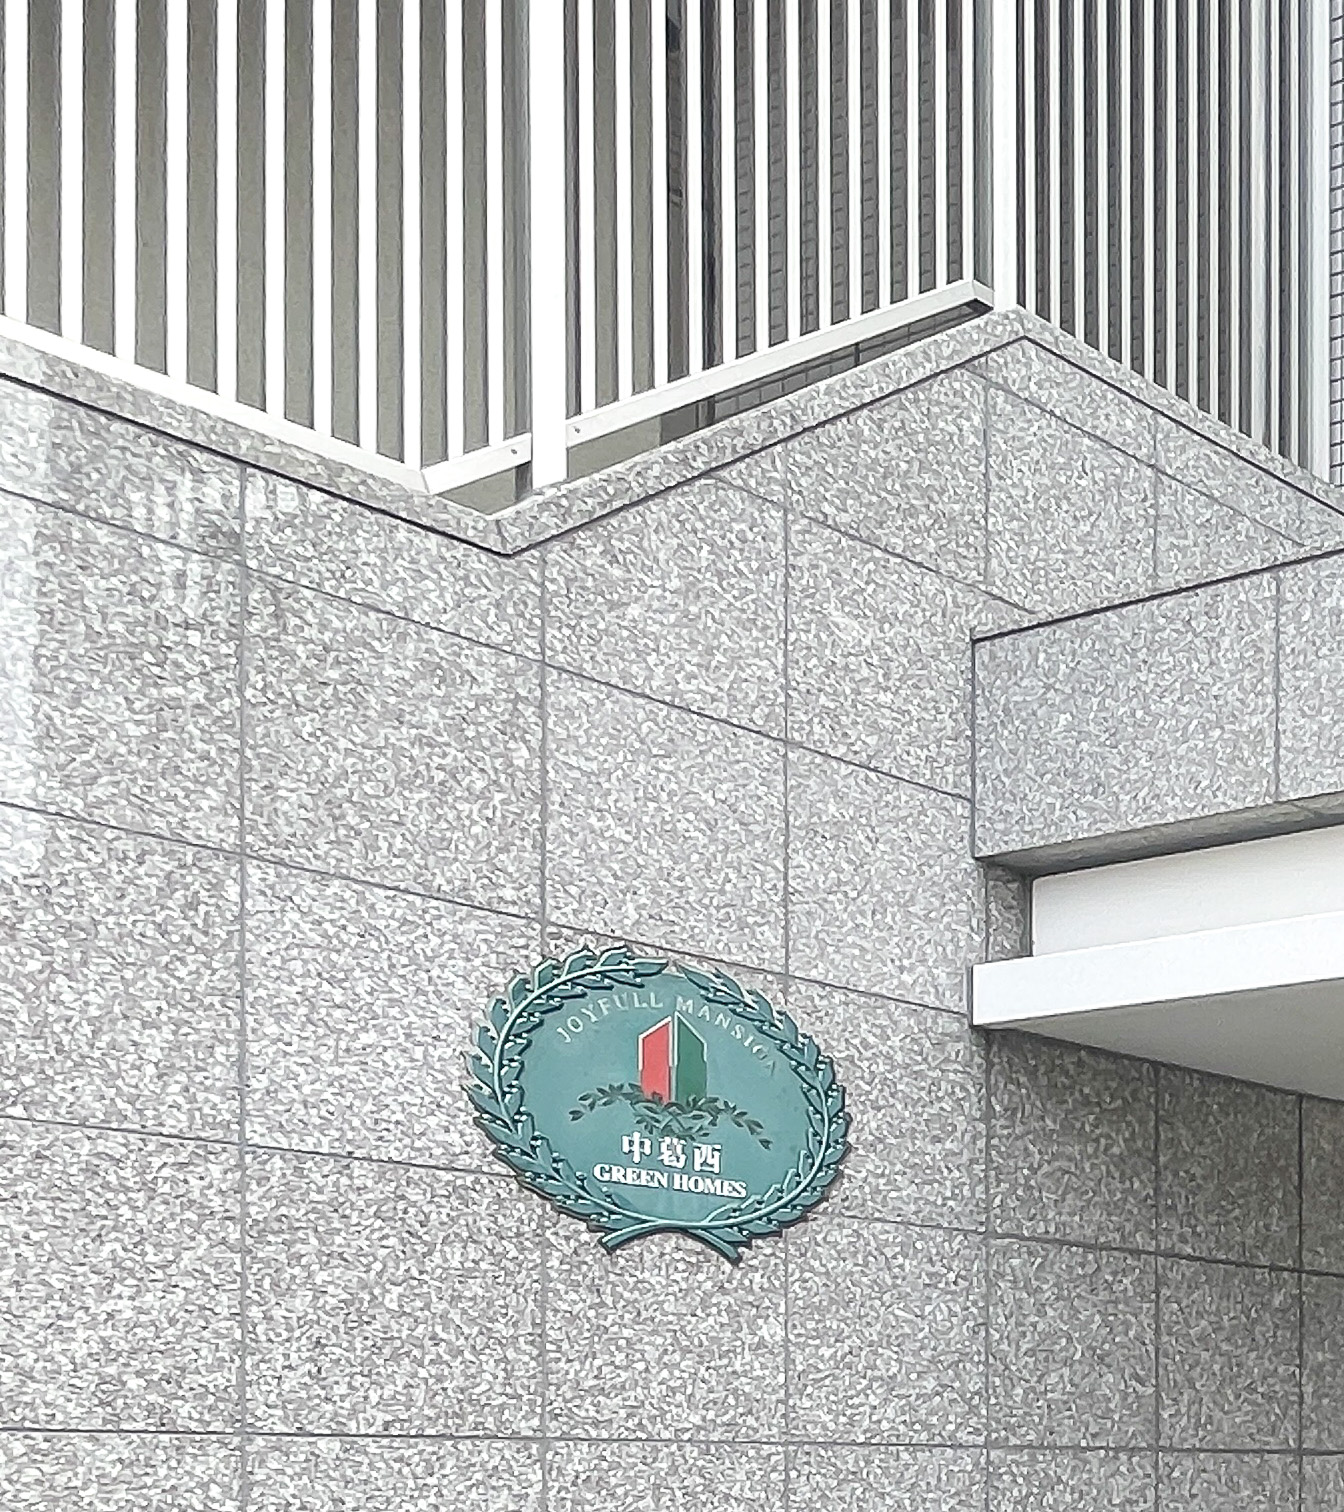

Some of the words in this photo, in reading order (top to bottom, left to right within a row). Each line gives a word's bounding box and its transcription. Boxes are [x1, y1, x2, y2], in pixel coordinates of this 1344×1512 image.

[555, 991, 664, 1043] JOYFULL
[621, 1131, 723, 1174] 中葛西
[593, 1163, 669, 1189] GREEN
[672, 1174, 748, 1198] HOMES
